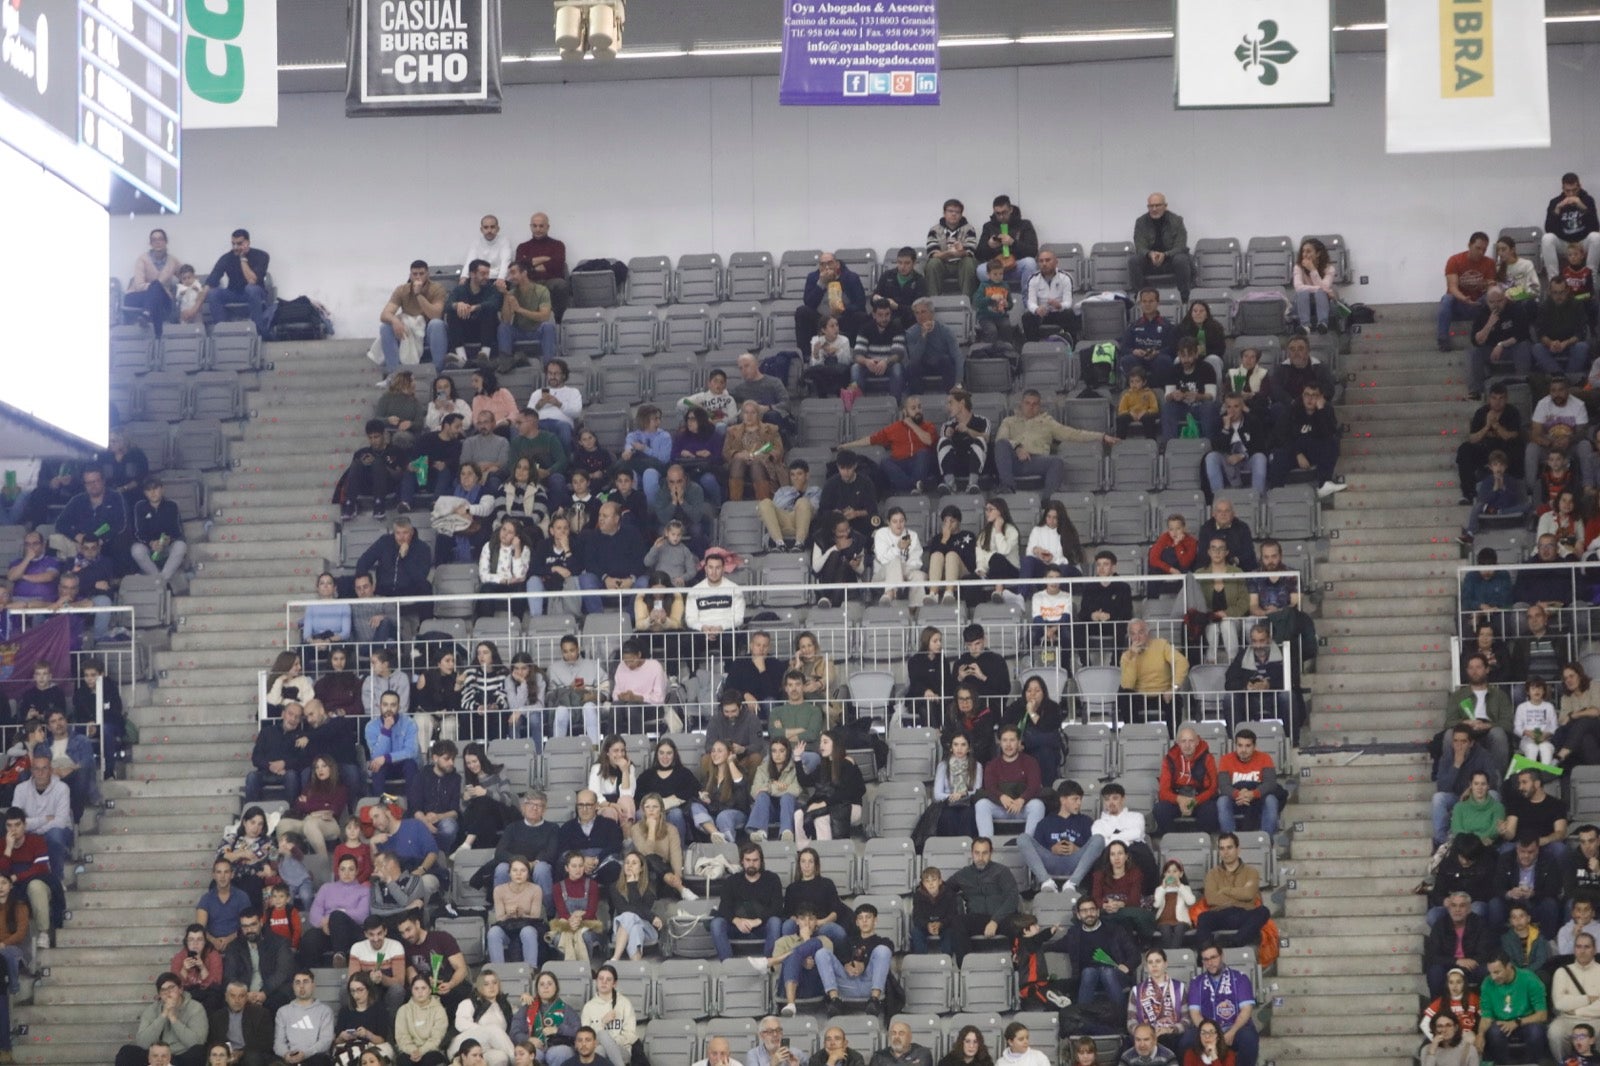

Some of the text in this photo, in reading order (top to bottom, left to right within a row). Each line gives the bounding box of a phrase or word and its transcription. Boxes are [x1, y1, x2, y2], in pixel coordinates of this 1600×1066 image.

[792, 2, 935, 15] Oya Abogados & Asesores
[380, 0, 468, 31] CASUAL
[784, 16, 816, 25] Camino
[817, 16, 827, 25] de
[901, 16, 935, 25] Granada
[807, 28, 822, 38] 958
[824, 28, 839, 38] 094
[380, 31, 468, 51] BURGER
[807, 40, 935, 54] info@oyaabogados.com
[809, 55, 935, 67] www.oyaabogados.com
